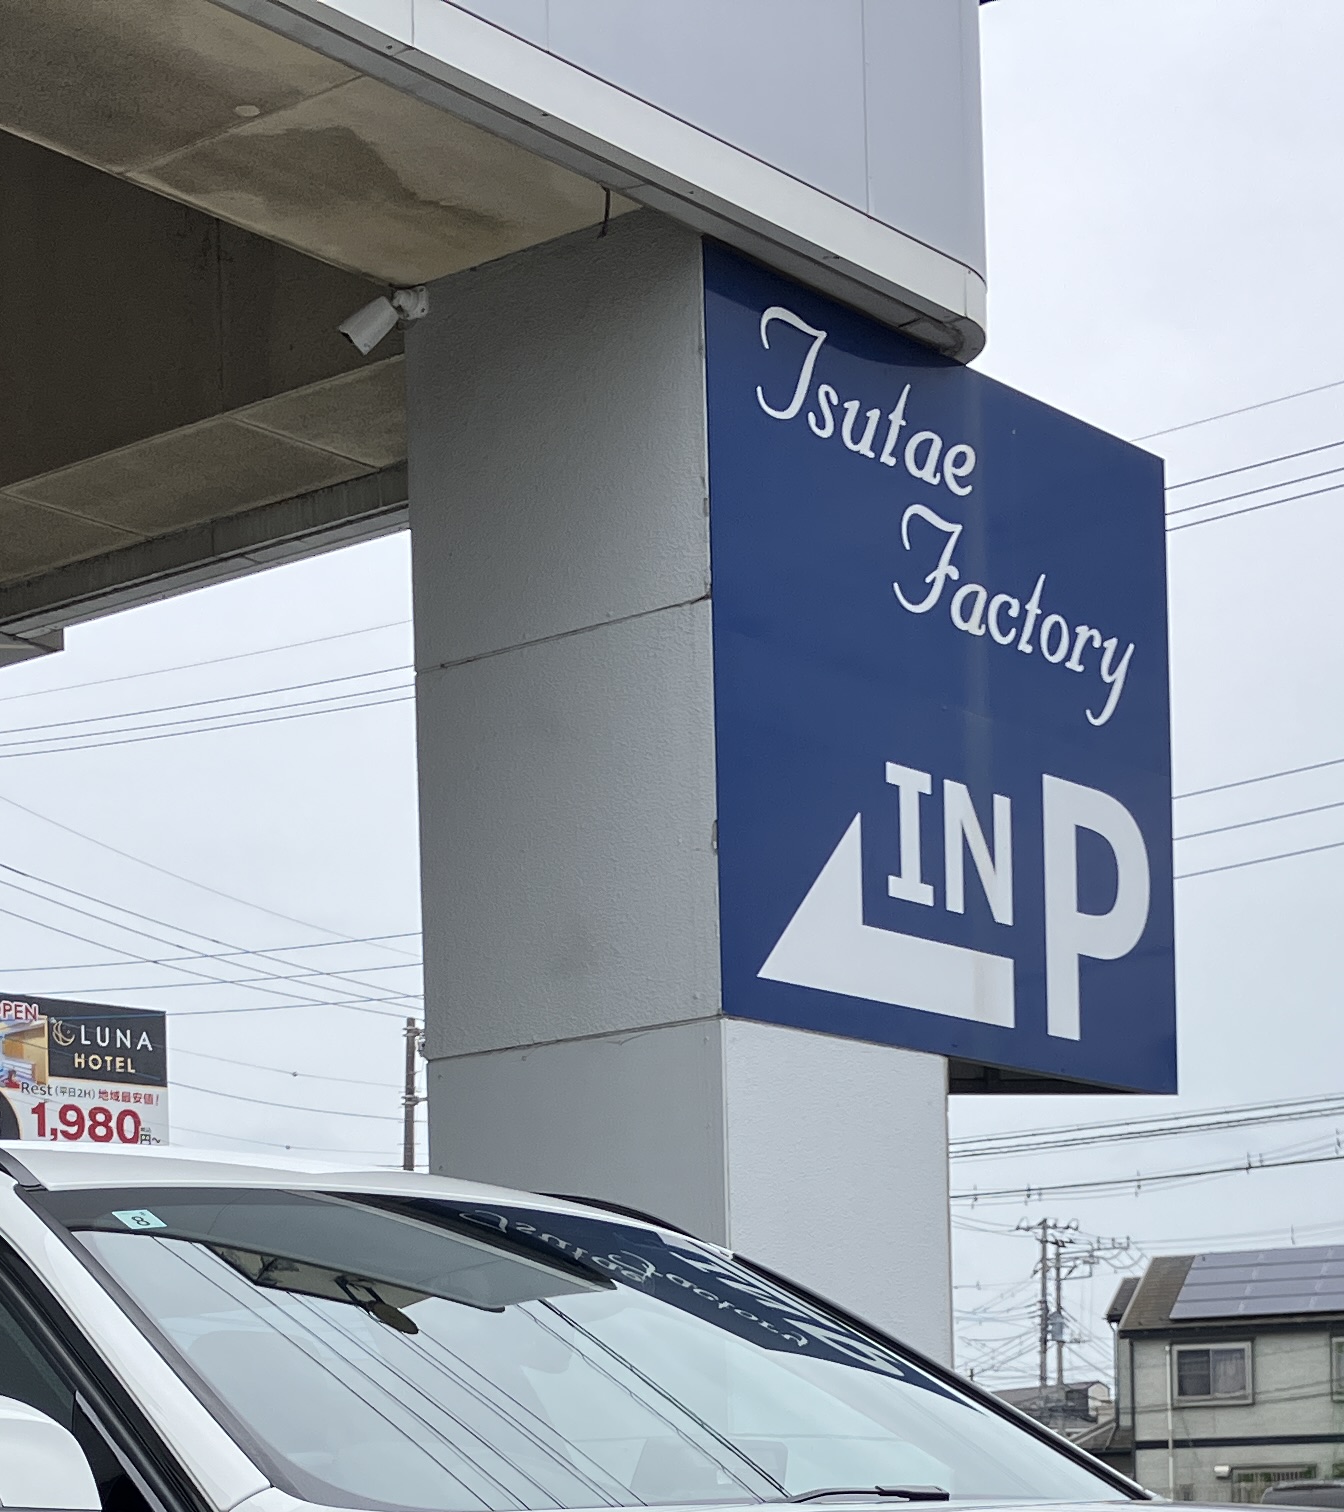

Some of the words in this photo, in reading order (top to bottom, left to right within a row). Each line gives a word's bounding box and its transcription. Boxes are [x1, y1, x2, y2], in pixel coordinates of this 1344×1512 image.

[756, 306, 977, 497] Tsutae
[893, 503, 1135, 727] Factory
[885, 761, 1015, 927] IN
[1042, 773, 1151, 1042] P
[80, 1024, 153, 1052] LUNA
[74, 1052, 136, 1073] HOTEL
[21, 1081, 53, 1097] Rest
[31, 1101, 142, 1145] 1,980
[131, 1215, 151, 1227] 8
